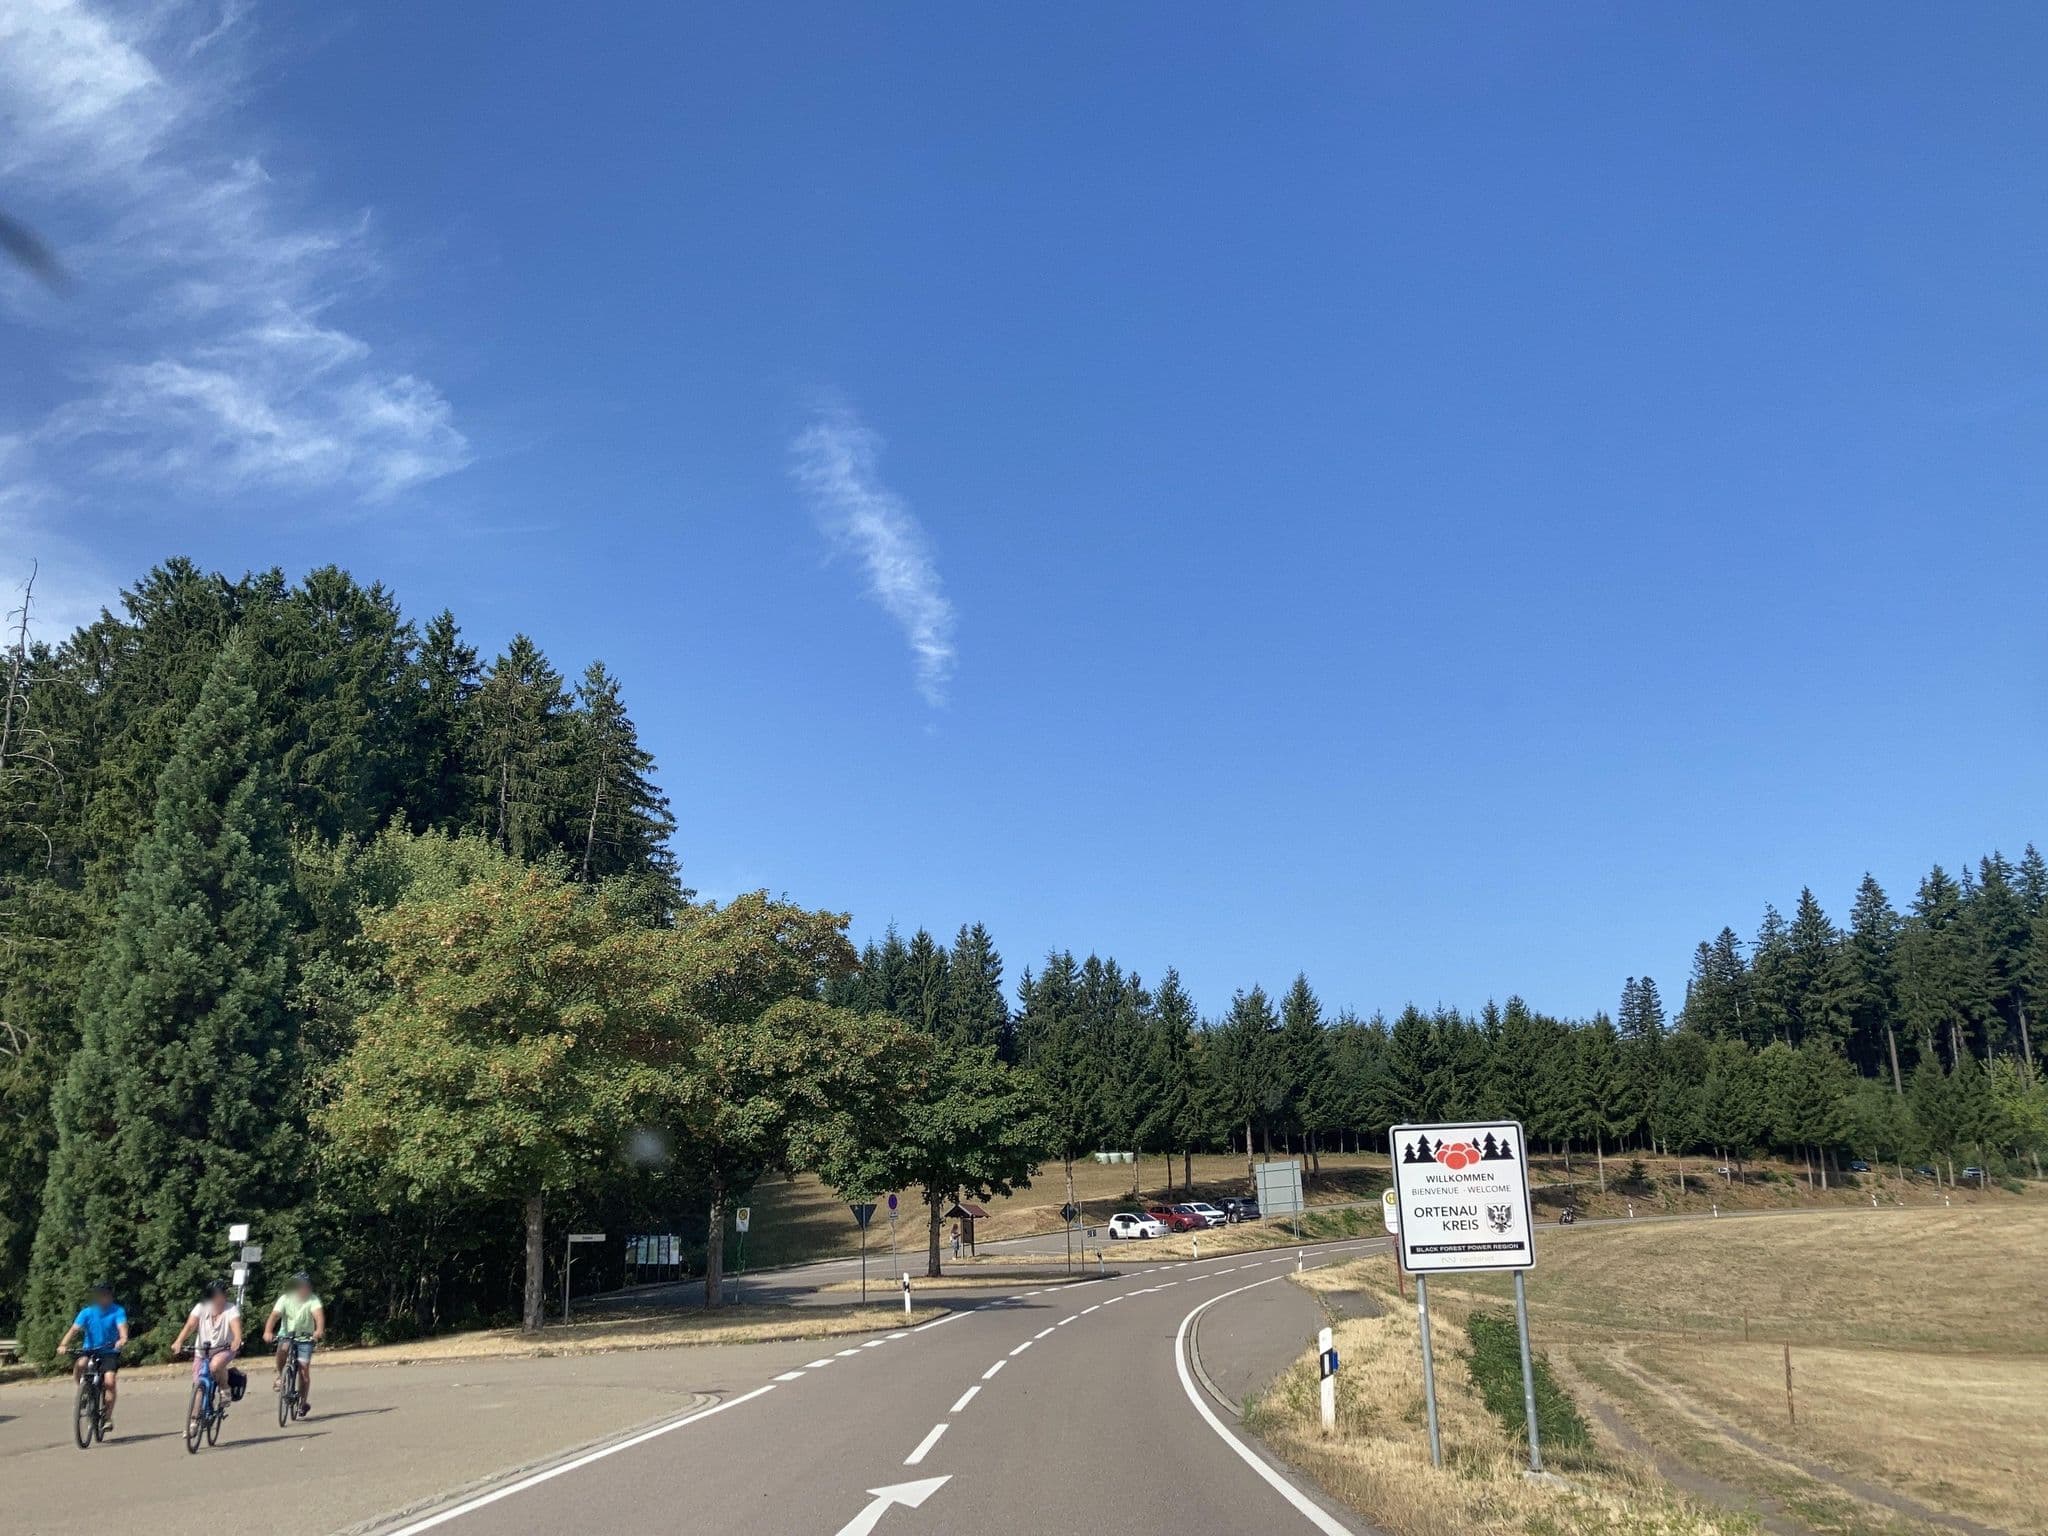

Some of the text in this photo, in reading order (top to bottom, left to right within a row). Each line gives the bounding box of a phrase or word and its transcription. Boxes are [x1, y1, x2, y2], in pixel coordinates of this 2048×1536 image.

[1426, 1173, 1495, 1183] WILLKOMMEN
[1412, 1184, 1512, 1196] BIENVENUE WELCOME
[1414, 1205, 1478, 1218] ORTENAU
[1443, 1219, 1479, 1231] KREIS
